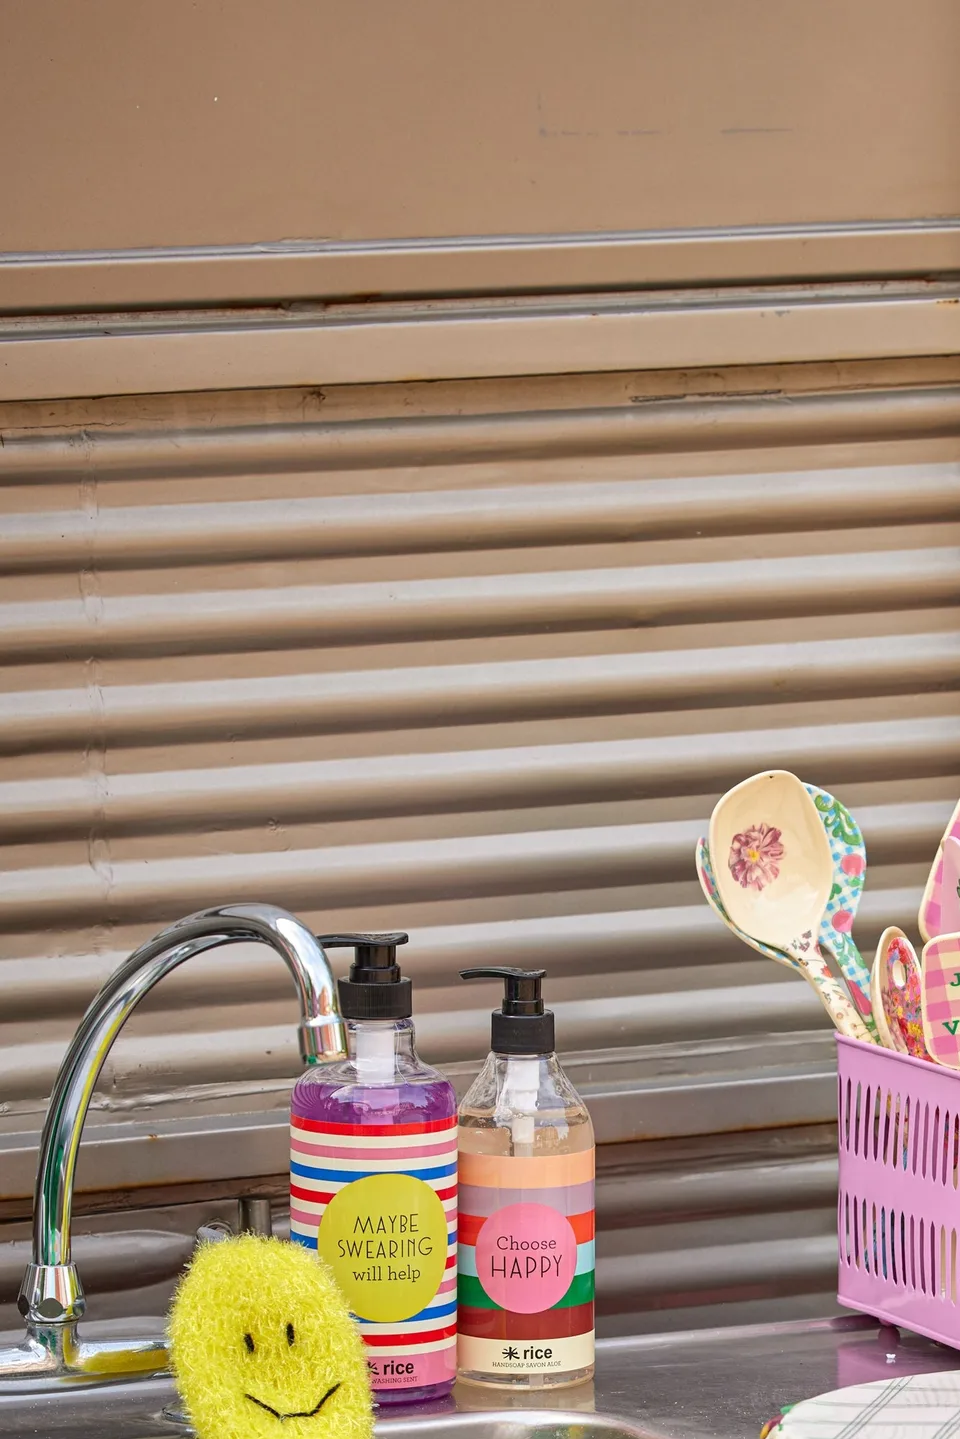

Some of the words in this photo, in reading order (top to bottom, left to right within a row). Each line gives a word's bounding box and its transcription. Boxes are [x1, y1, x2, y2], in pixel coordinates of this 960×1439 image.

[353, 1213, 419, 1234] MAYBE
[337, 1236, 433, 1259] SWEARING
[496, 1235, 557, 1251] Choose
[352, 1265, 382, 1281] will
[387, 1264, 421, 1283] help
[491, 1254, 563, 1279] HAPPY
[523, 1345, 553, 1360] rice
[383, 1360, 415, 1375] rice
[492, 1361, 525, 1369] HANDSOAP
